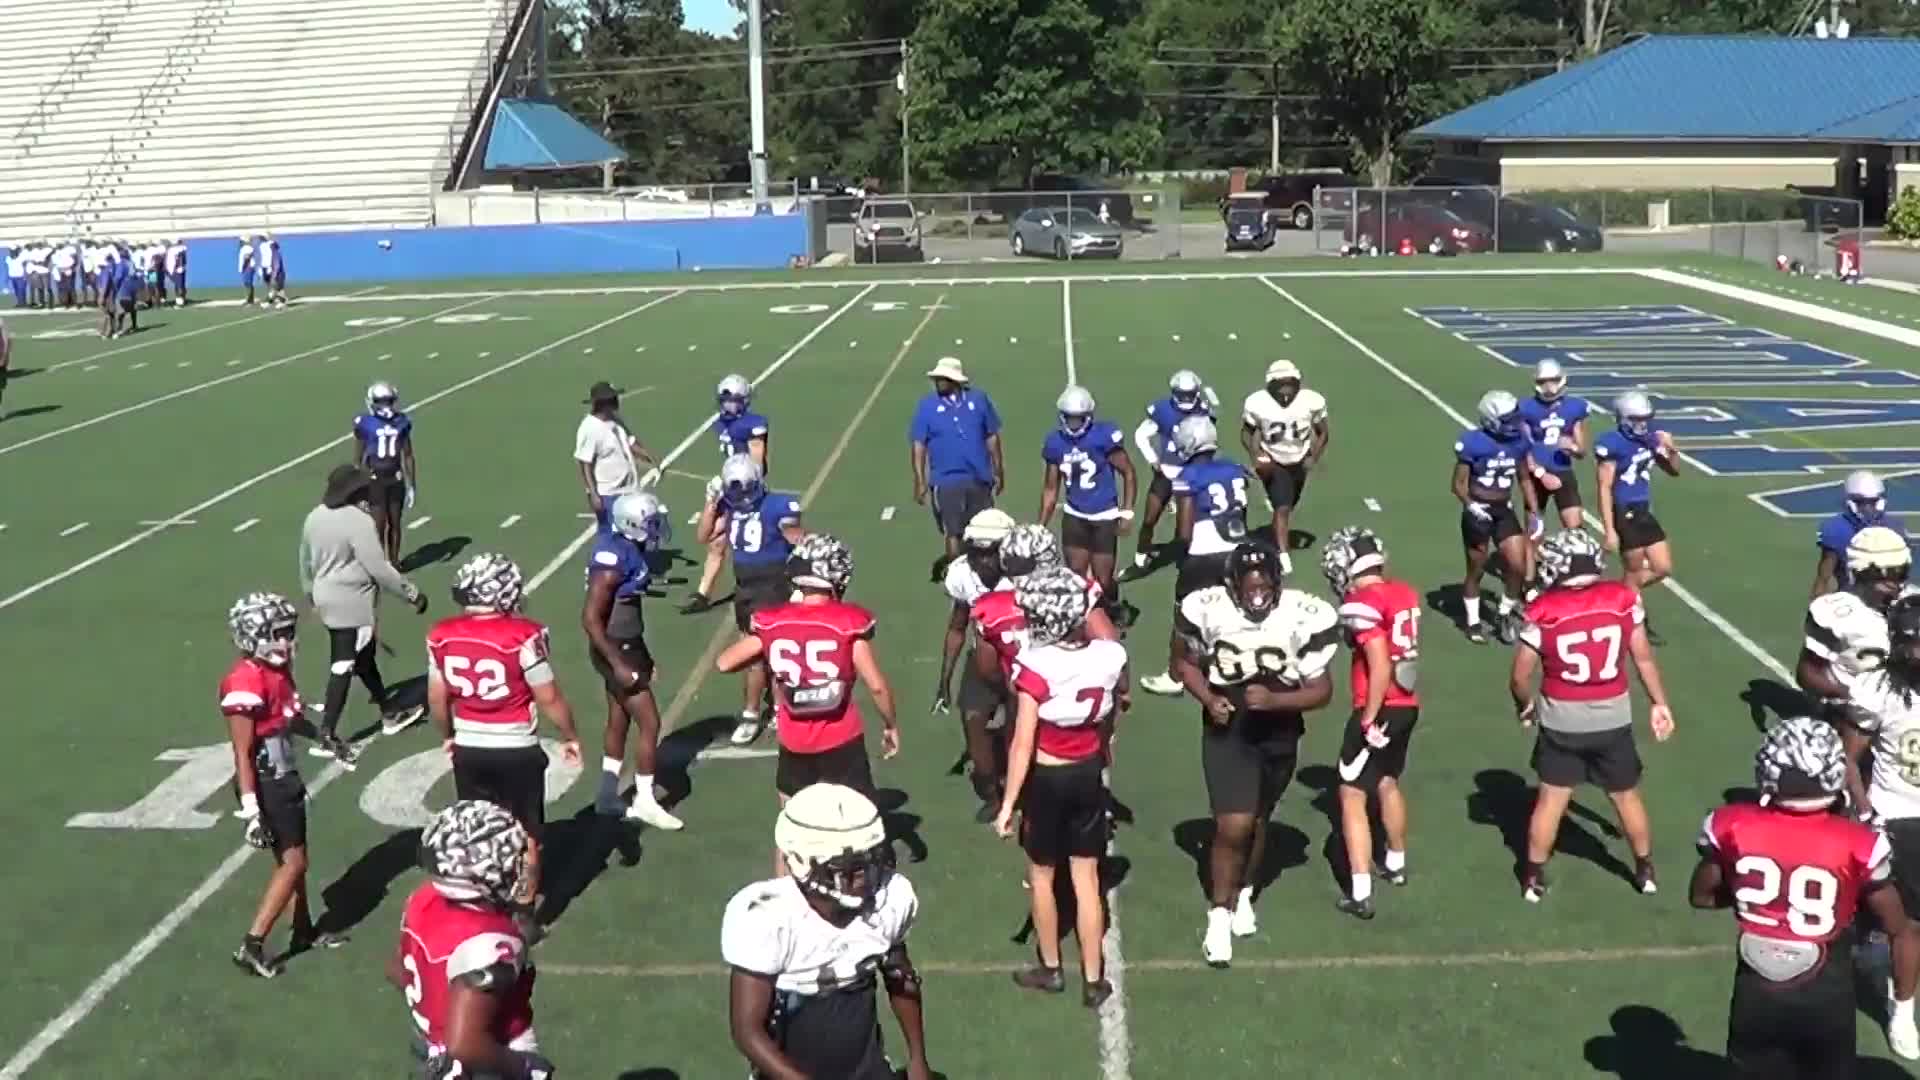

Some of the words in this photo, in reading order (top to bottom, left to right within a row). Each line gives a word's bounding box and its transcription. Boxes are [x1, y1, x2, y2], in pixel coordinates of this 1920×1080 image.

[1059, 458, 1097, 489] 12
[1207, 478, 1248, 515] 35
[730, 519, 763, 553] 19
[768, 638, 839, 688] 65
[1556, 624, 1622, 683] 57
[443, 655, 511, 700] 52
[1075, 686, 1106, 724] 7
[65, 743, 583, 829] 10
[1734, 854, 1838, 937] 28
